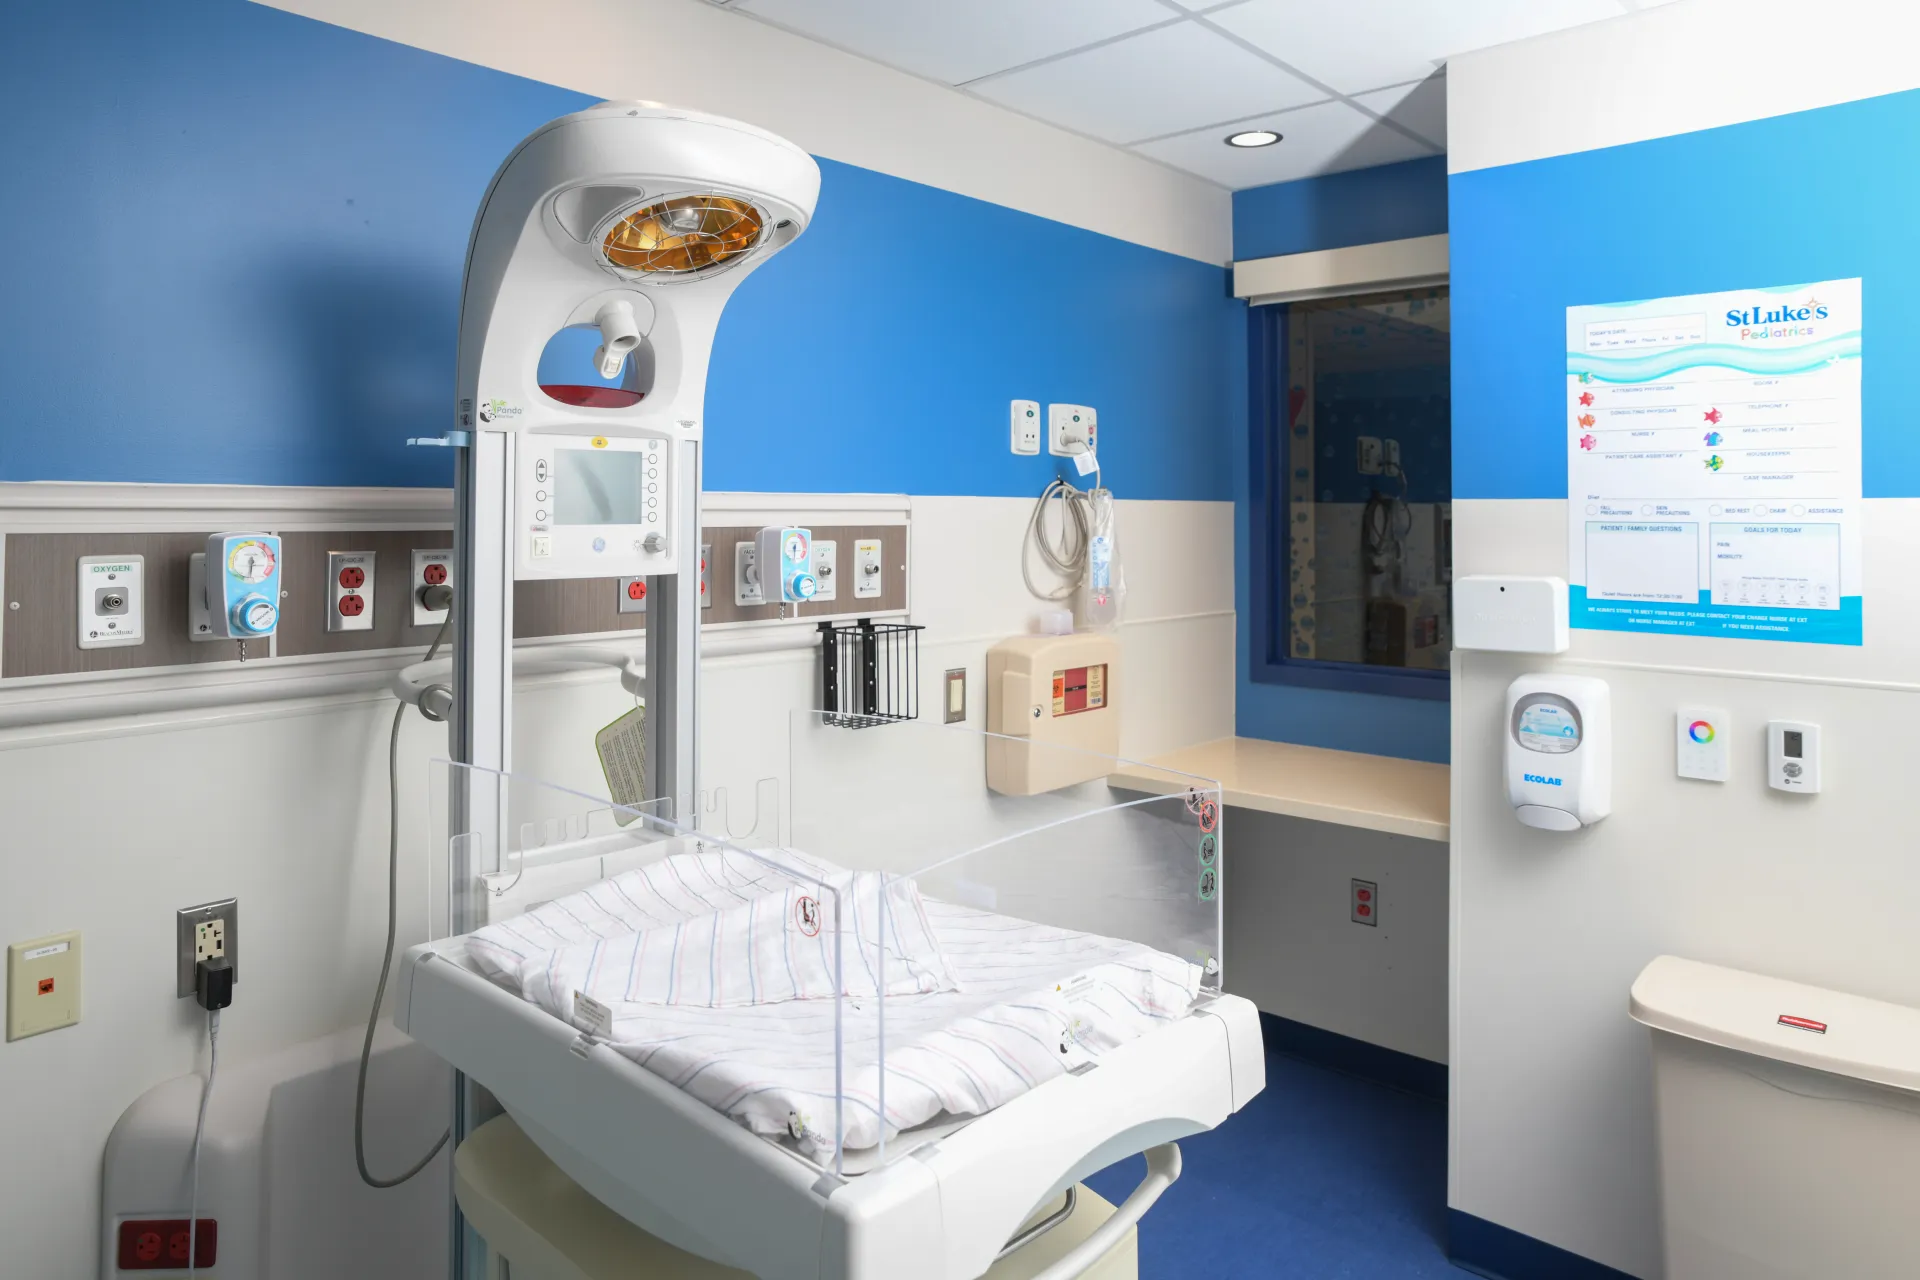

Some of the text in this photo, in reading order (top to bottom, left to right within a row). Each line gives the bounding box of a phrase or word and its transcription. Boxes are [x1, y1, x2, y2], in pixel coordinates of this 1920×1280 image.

[1741, 326, 1814, 340] Pediatrics
[497, 407, 522, 416] Panda
[93, 565, 130, 573] OXYGEN
[1524, 774, 1562, 786] ECOLAB
